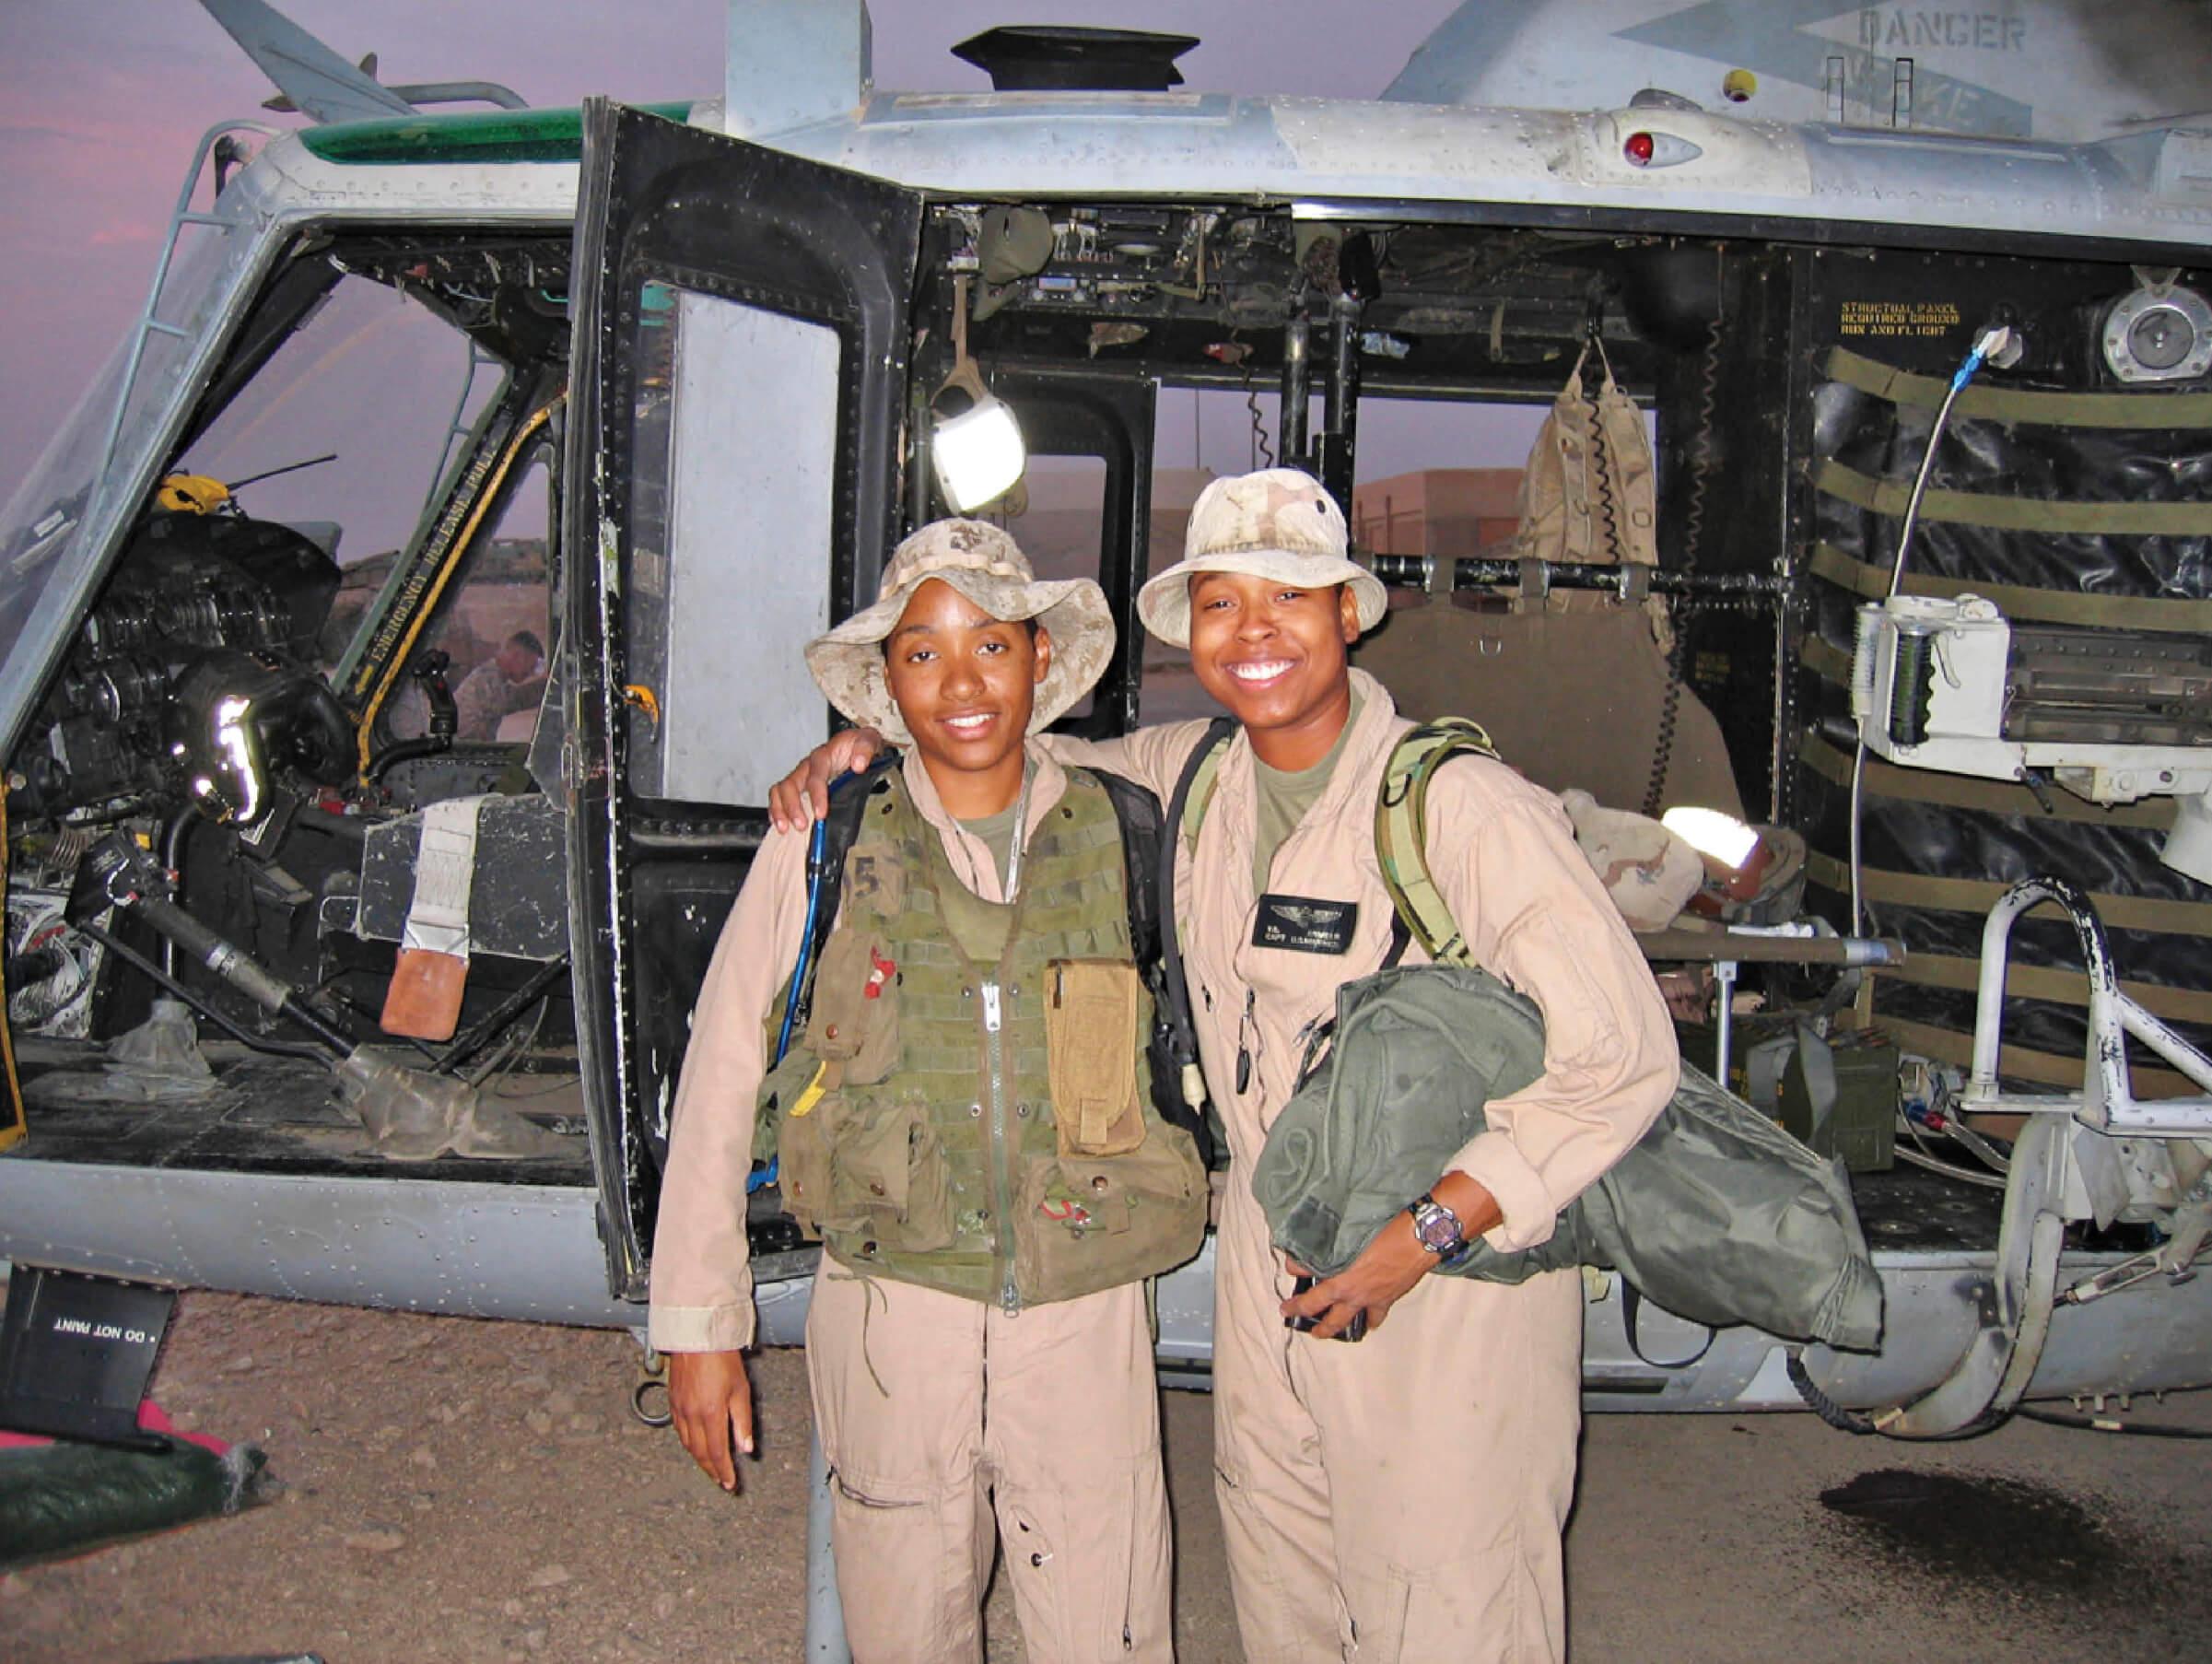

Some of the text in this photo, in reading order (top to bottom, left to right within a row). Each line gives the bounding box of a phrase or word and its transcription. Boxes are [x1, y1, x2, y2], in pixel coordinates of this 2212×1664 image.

[1858, 9, 2026, 51] DANGER
[1916, 302, 1958, 313] PANEL
[1841, 312, 1960, 324] REQUIRED GROUND
[1841, 324, 1946, 336] RUN AND FLIGHT
[371, 449, 497, 662] EMERGENCY RELEASE PULL
[53, 1317, 146, 1342] DO NOT PAINT
